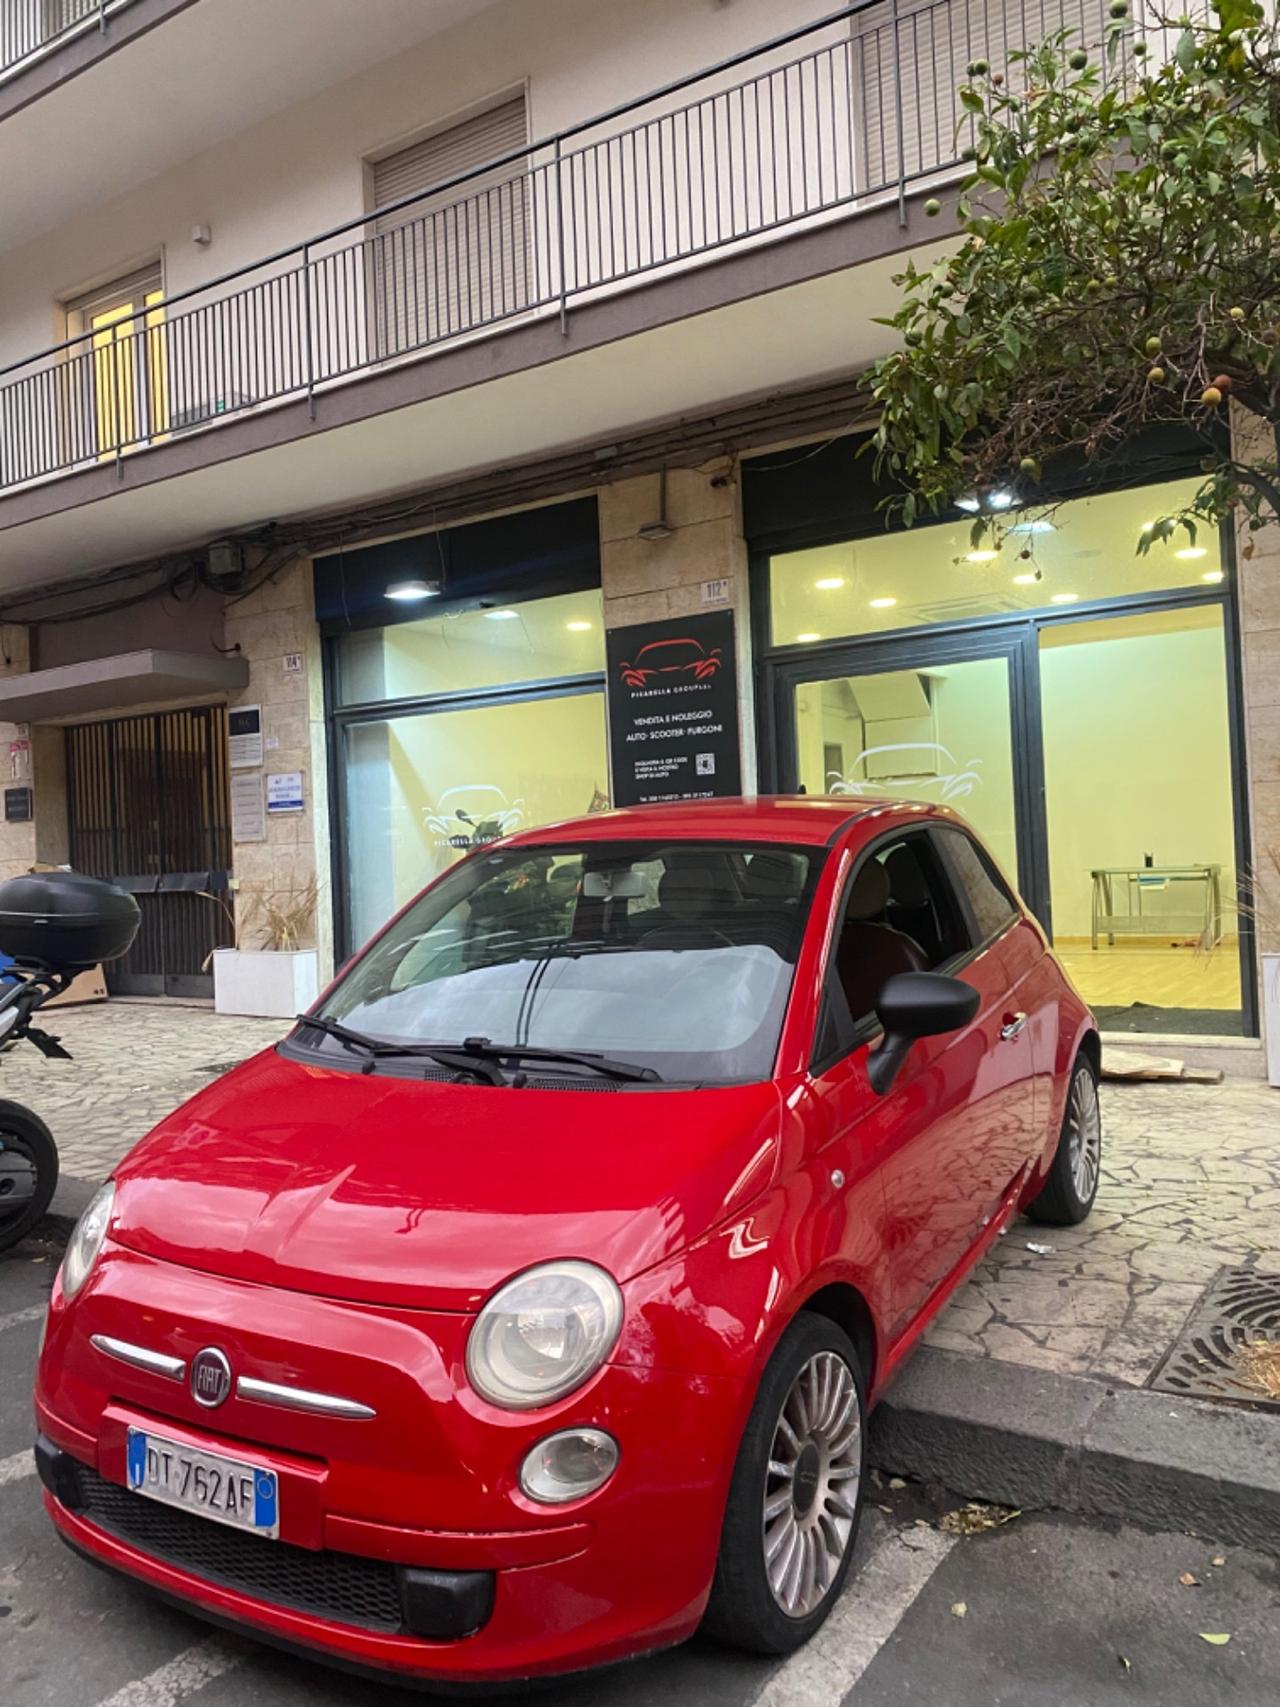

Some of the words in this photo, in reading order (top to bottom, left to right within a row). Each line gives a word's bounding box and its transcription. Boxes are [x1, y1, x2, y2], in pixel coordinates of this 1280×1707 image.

[633, 715, 664, 726] VENDITA
[665, 714, 670, 723] E
[671, 710, 713, 722] NOLEGGIO
[687, 724, 722, 736] FURGONI
[198, 1364, 222, 1395] FIAT
